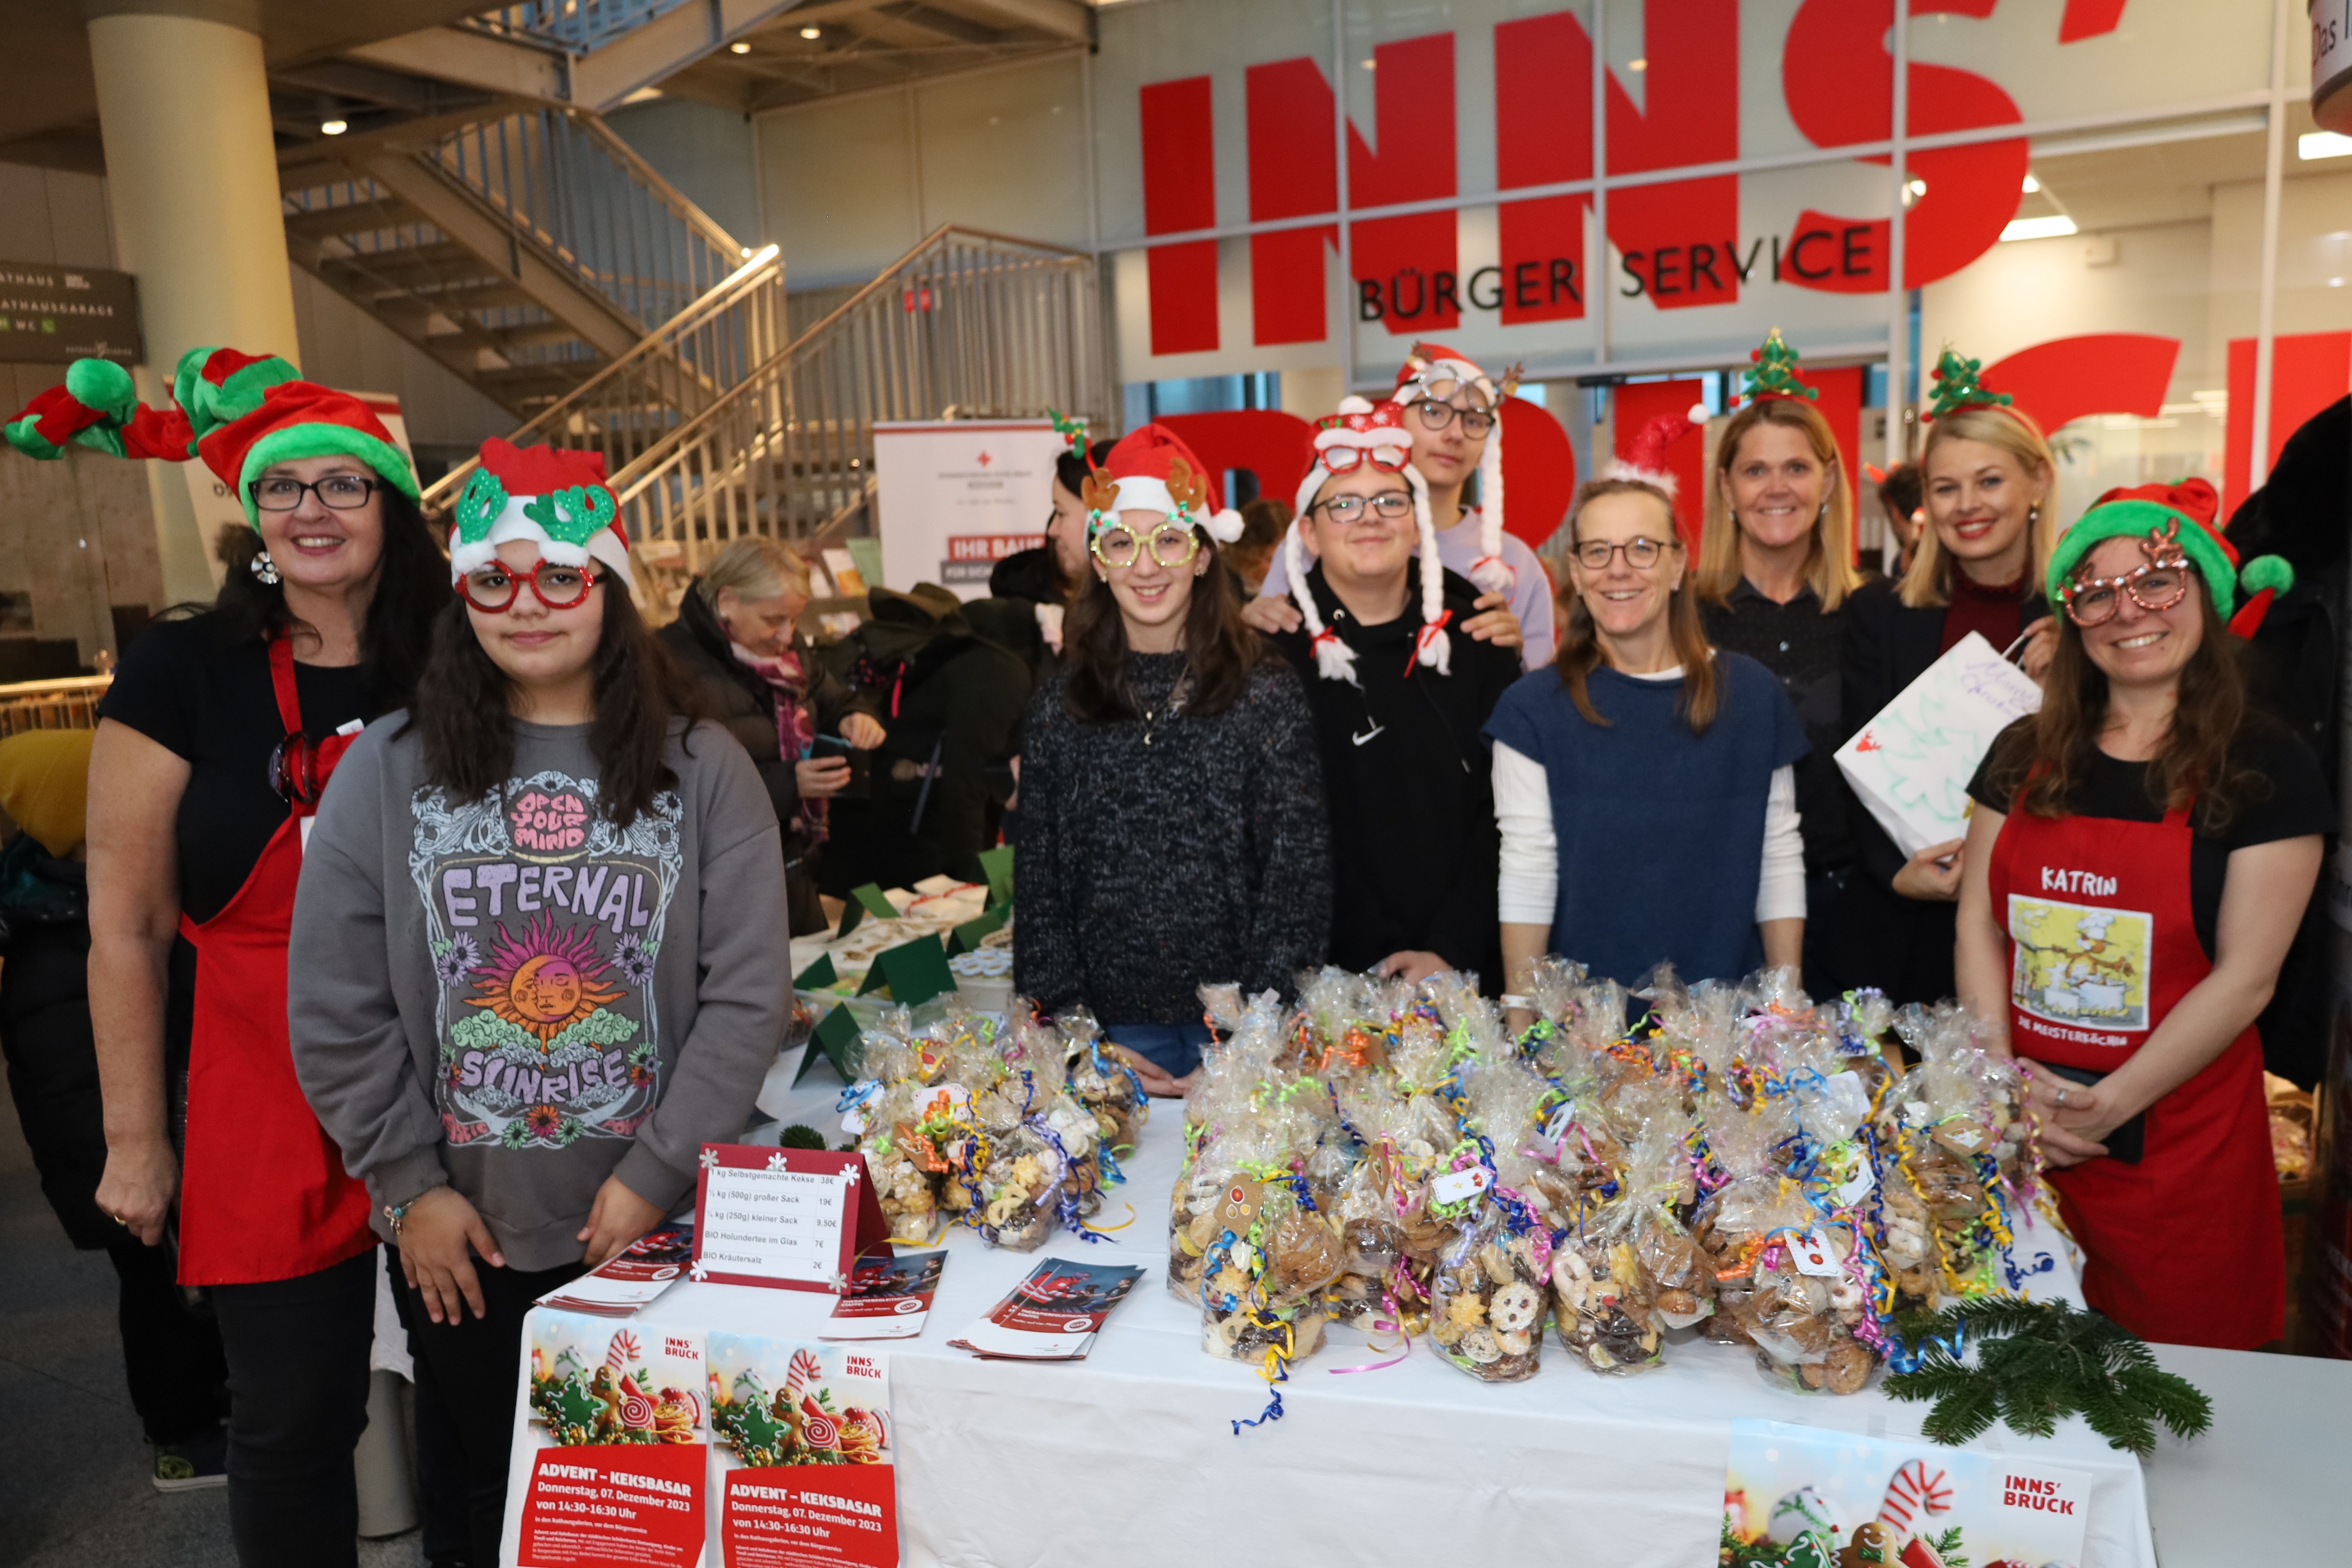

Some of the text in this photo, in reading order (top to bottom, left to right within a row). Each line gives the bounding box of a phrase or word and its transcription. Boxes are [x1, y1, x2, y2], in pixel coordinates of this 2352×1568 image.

[1358, 225, 1873, 323] BÜRGER SERVICE
[954, 539, 988, 559] IHR
[515, 792, 584, 813] OPEN
[510, 810, 588, 832] YOUR
[514, 827, 585, 850] MIND
[2041, 866, 2117, 896] KATRIN
[442, 862, 649, 934] ETERNAL
[461, 1048, 628, 1105] SUNRISE
[717, 1169, 726, 1178] kg
[728, 1170, 789, 1181] Selbstgemachte
[791, 1175, 815, 1183] Kekse
[717, 1190, 726, 1199] kg
[728, 1191, 751, 1201] (500g)
[754, 1193, 779, 1202] großer
[715, 1211, 724, 1220] kg
[726, 1212, 749, 1222] (250g)
[752, 1213, 777, 1222] kleiner
[780, 1216, 798, 1224] Sack
[721, 1232, 767, 1243] Holundertee
[719, 1253, 762, 1264] Kräutersalz
[665, 1337, 692, 1348] INNS'
[664, 1346, 699, 1360] BRUCK
[846, 1355, 875, 1367] INNS'
[846, 1364, 881, 1379] BRUCK
[538, 1462, 598, 1481] ADVENT
[609, 1471, 692, 1497] KEKSBASAR
[2006, 1475, 2061, 1495] INNS'
[537, 1481, 690, 1512] Donnerstag, 07. Dezember 2023
[730, 1483, 787, 1500] ADVENT
[800, 1491, 883, 1517] KEKSBASAR
[2004, 1491, 2074, 1515] BRUCK
[536, 1500, 637, 1519] von 14:30-16:30 Uhr
[731, 1500, 882, 1532] Donnerstag, 07. Dezember 2023
[732, 1518, 830, 1538] von 14:30-16:30 Uhr
